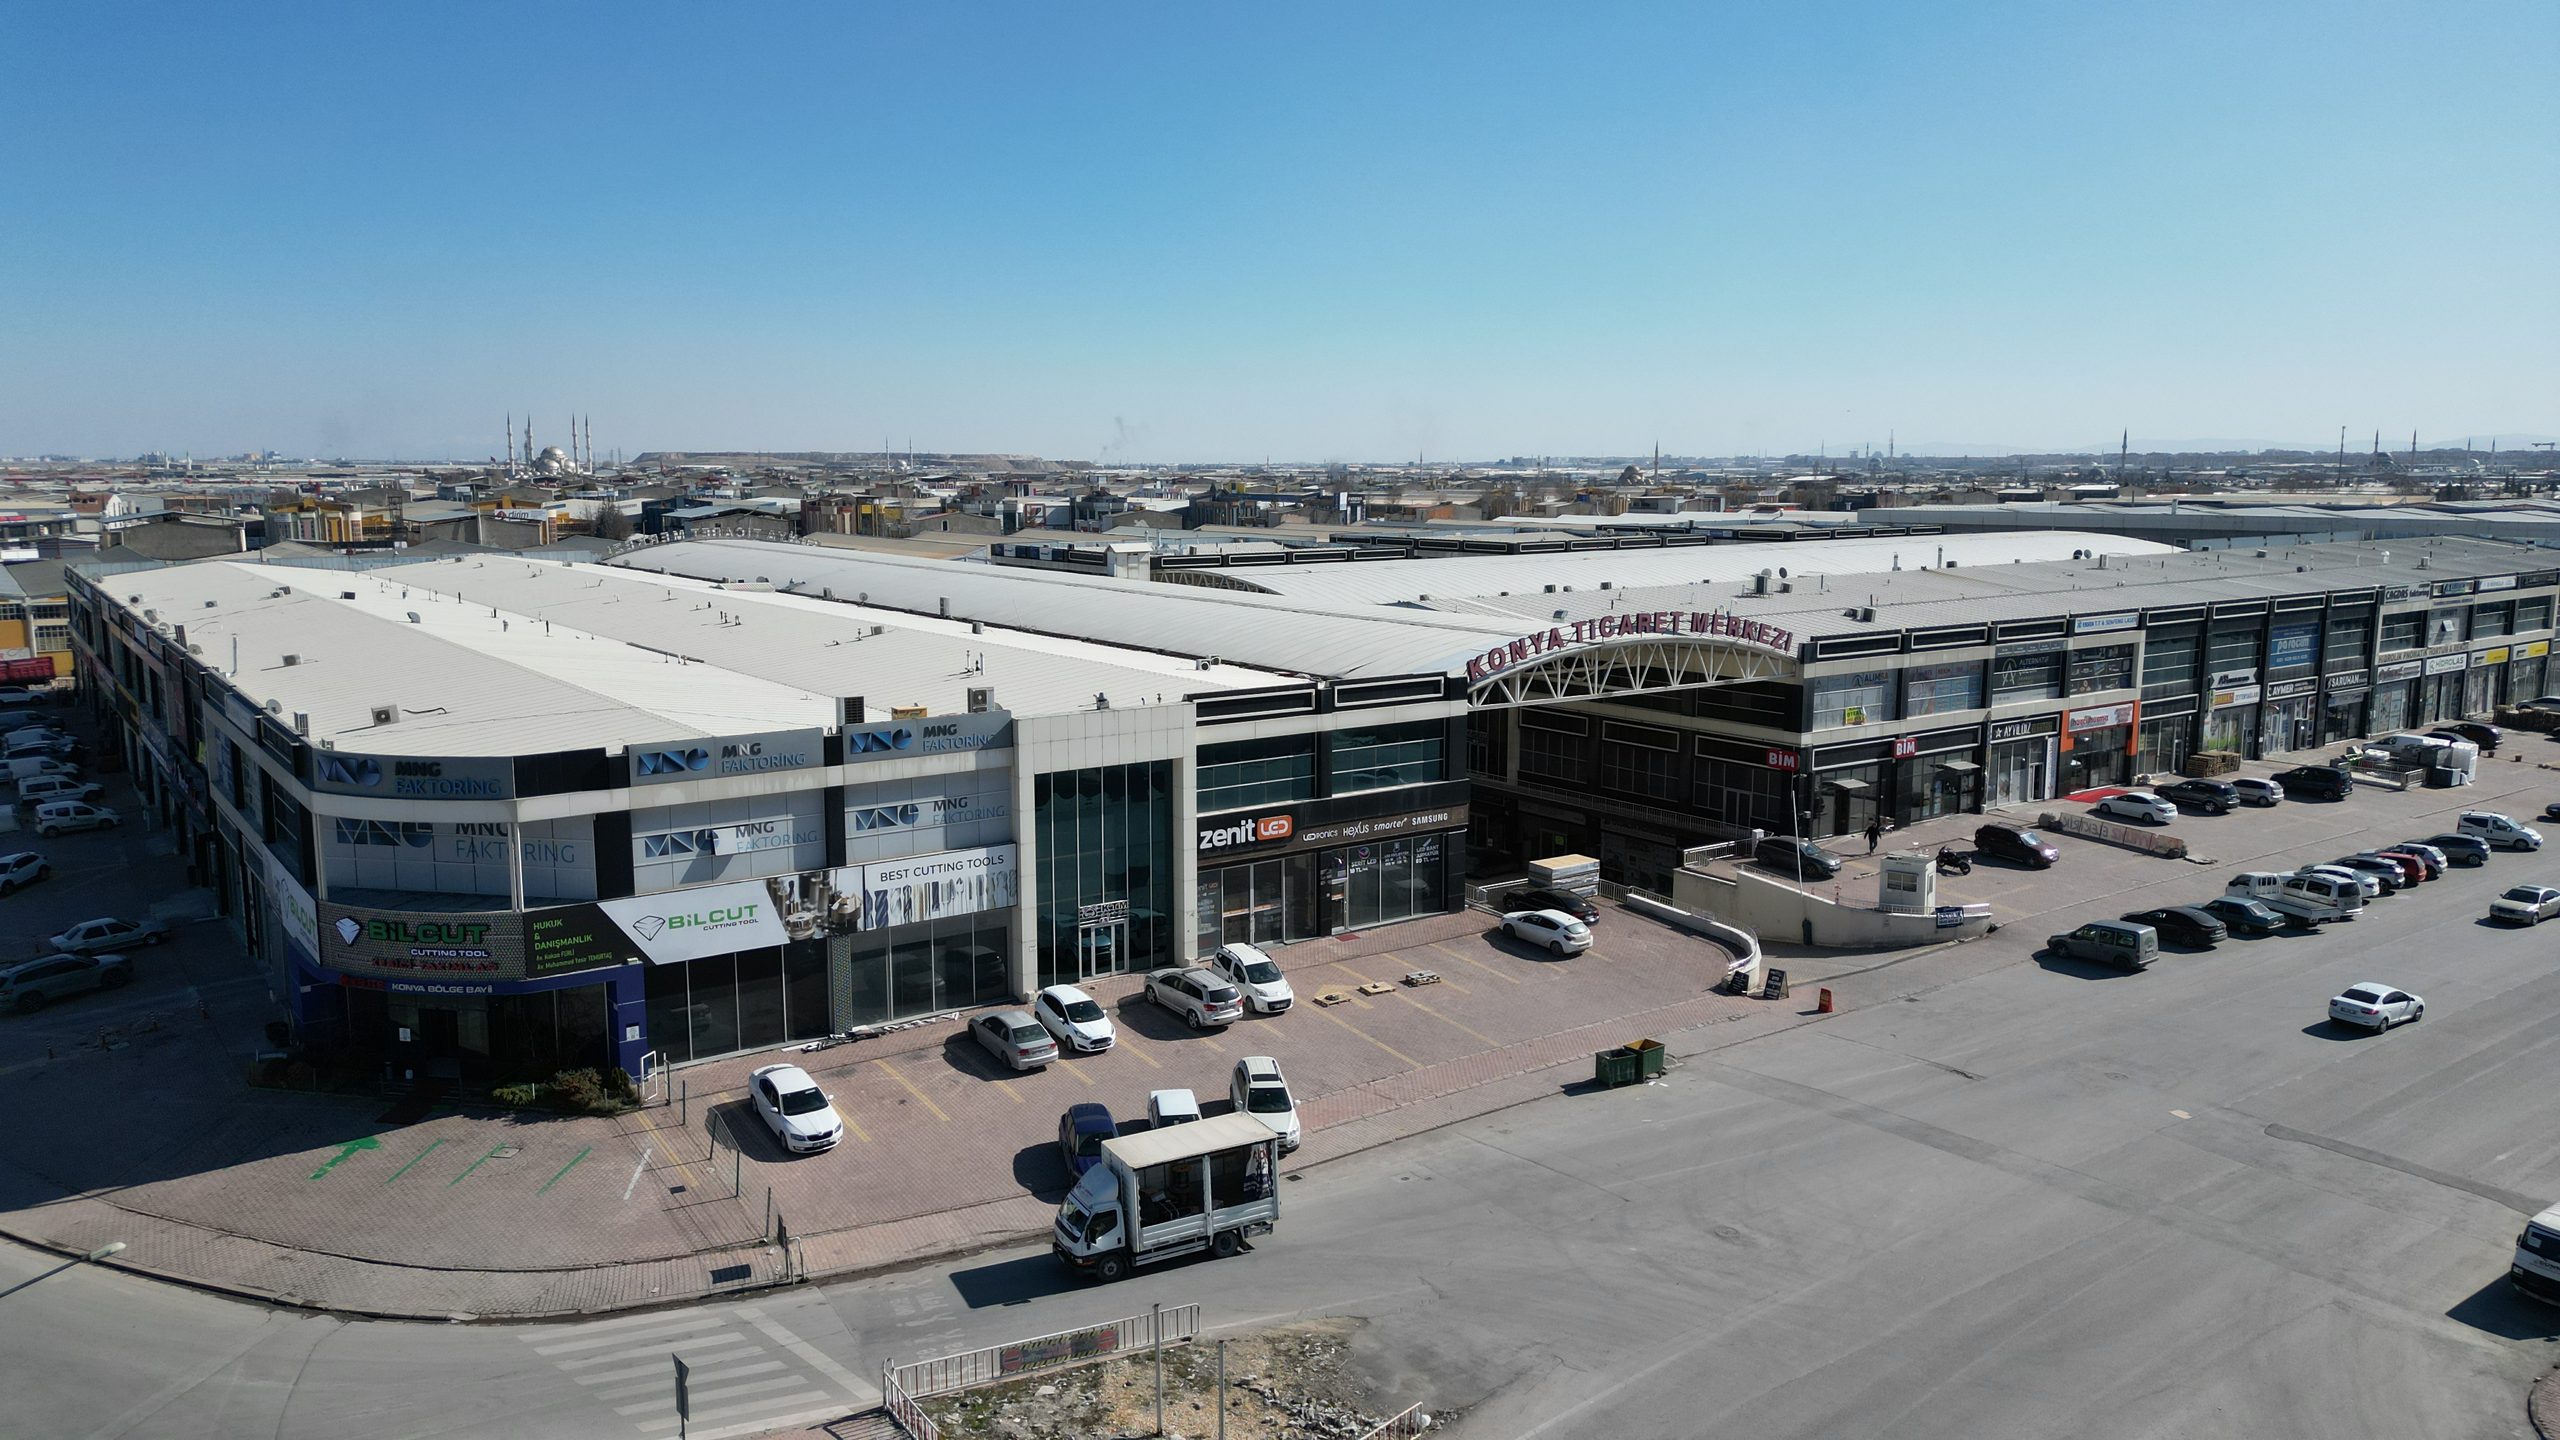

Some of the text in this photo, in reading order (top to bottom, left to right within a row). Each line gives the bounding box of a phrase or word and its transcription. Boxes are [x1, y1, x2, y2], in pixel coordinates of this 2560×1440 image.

[1466, 627, 1565, 681] KONYA
[1571, 611, 1685, 644] TİCARET
[923, 724, 958, 738] MNG
[721, 742, 762, 759] MNG
[1896, 739, 1917, 757] BİM
[721, 752, 806, 773] FAKTORİNG
[1768, 750, 1796, 768] BİM
[395, 761, 442, 777] MNG
[396, 776, 501, 795] FAKTORİNG
[933, 796, 968, 812] MNG
[1411, 812, 1449, 826] SAMSUNG
[735, 821, 775, 838] MNG
[1199, 818, 1290, 849] zenit LED
[880, 854, 1005, 882] BEST CUTTING TOOLS
[533, 919, 564, 931] HUKUK
[703, 920, 737, 931] CUTTING
[534, 932, 541, 940] &
[534, 934, 593, 950] DANIŞMANLIK
[410, 949, 489, 958] CUTTING TOOL
[391, 982, 426, 993] KONYA
[427, 984, 465, 994] BÖLGE
